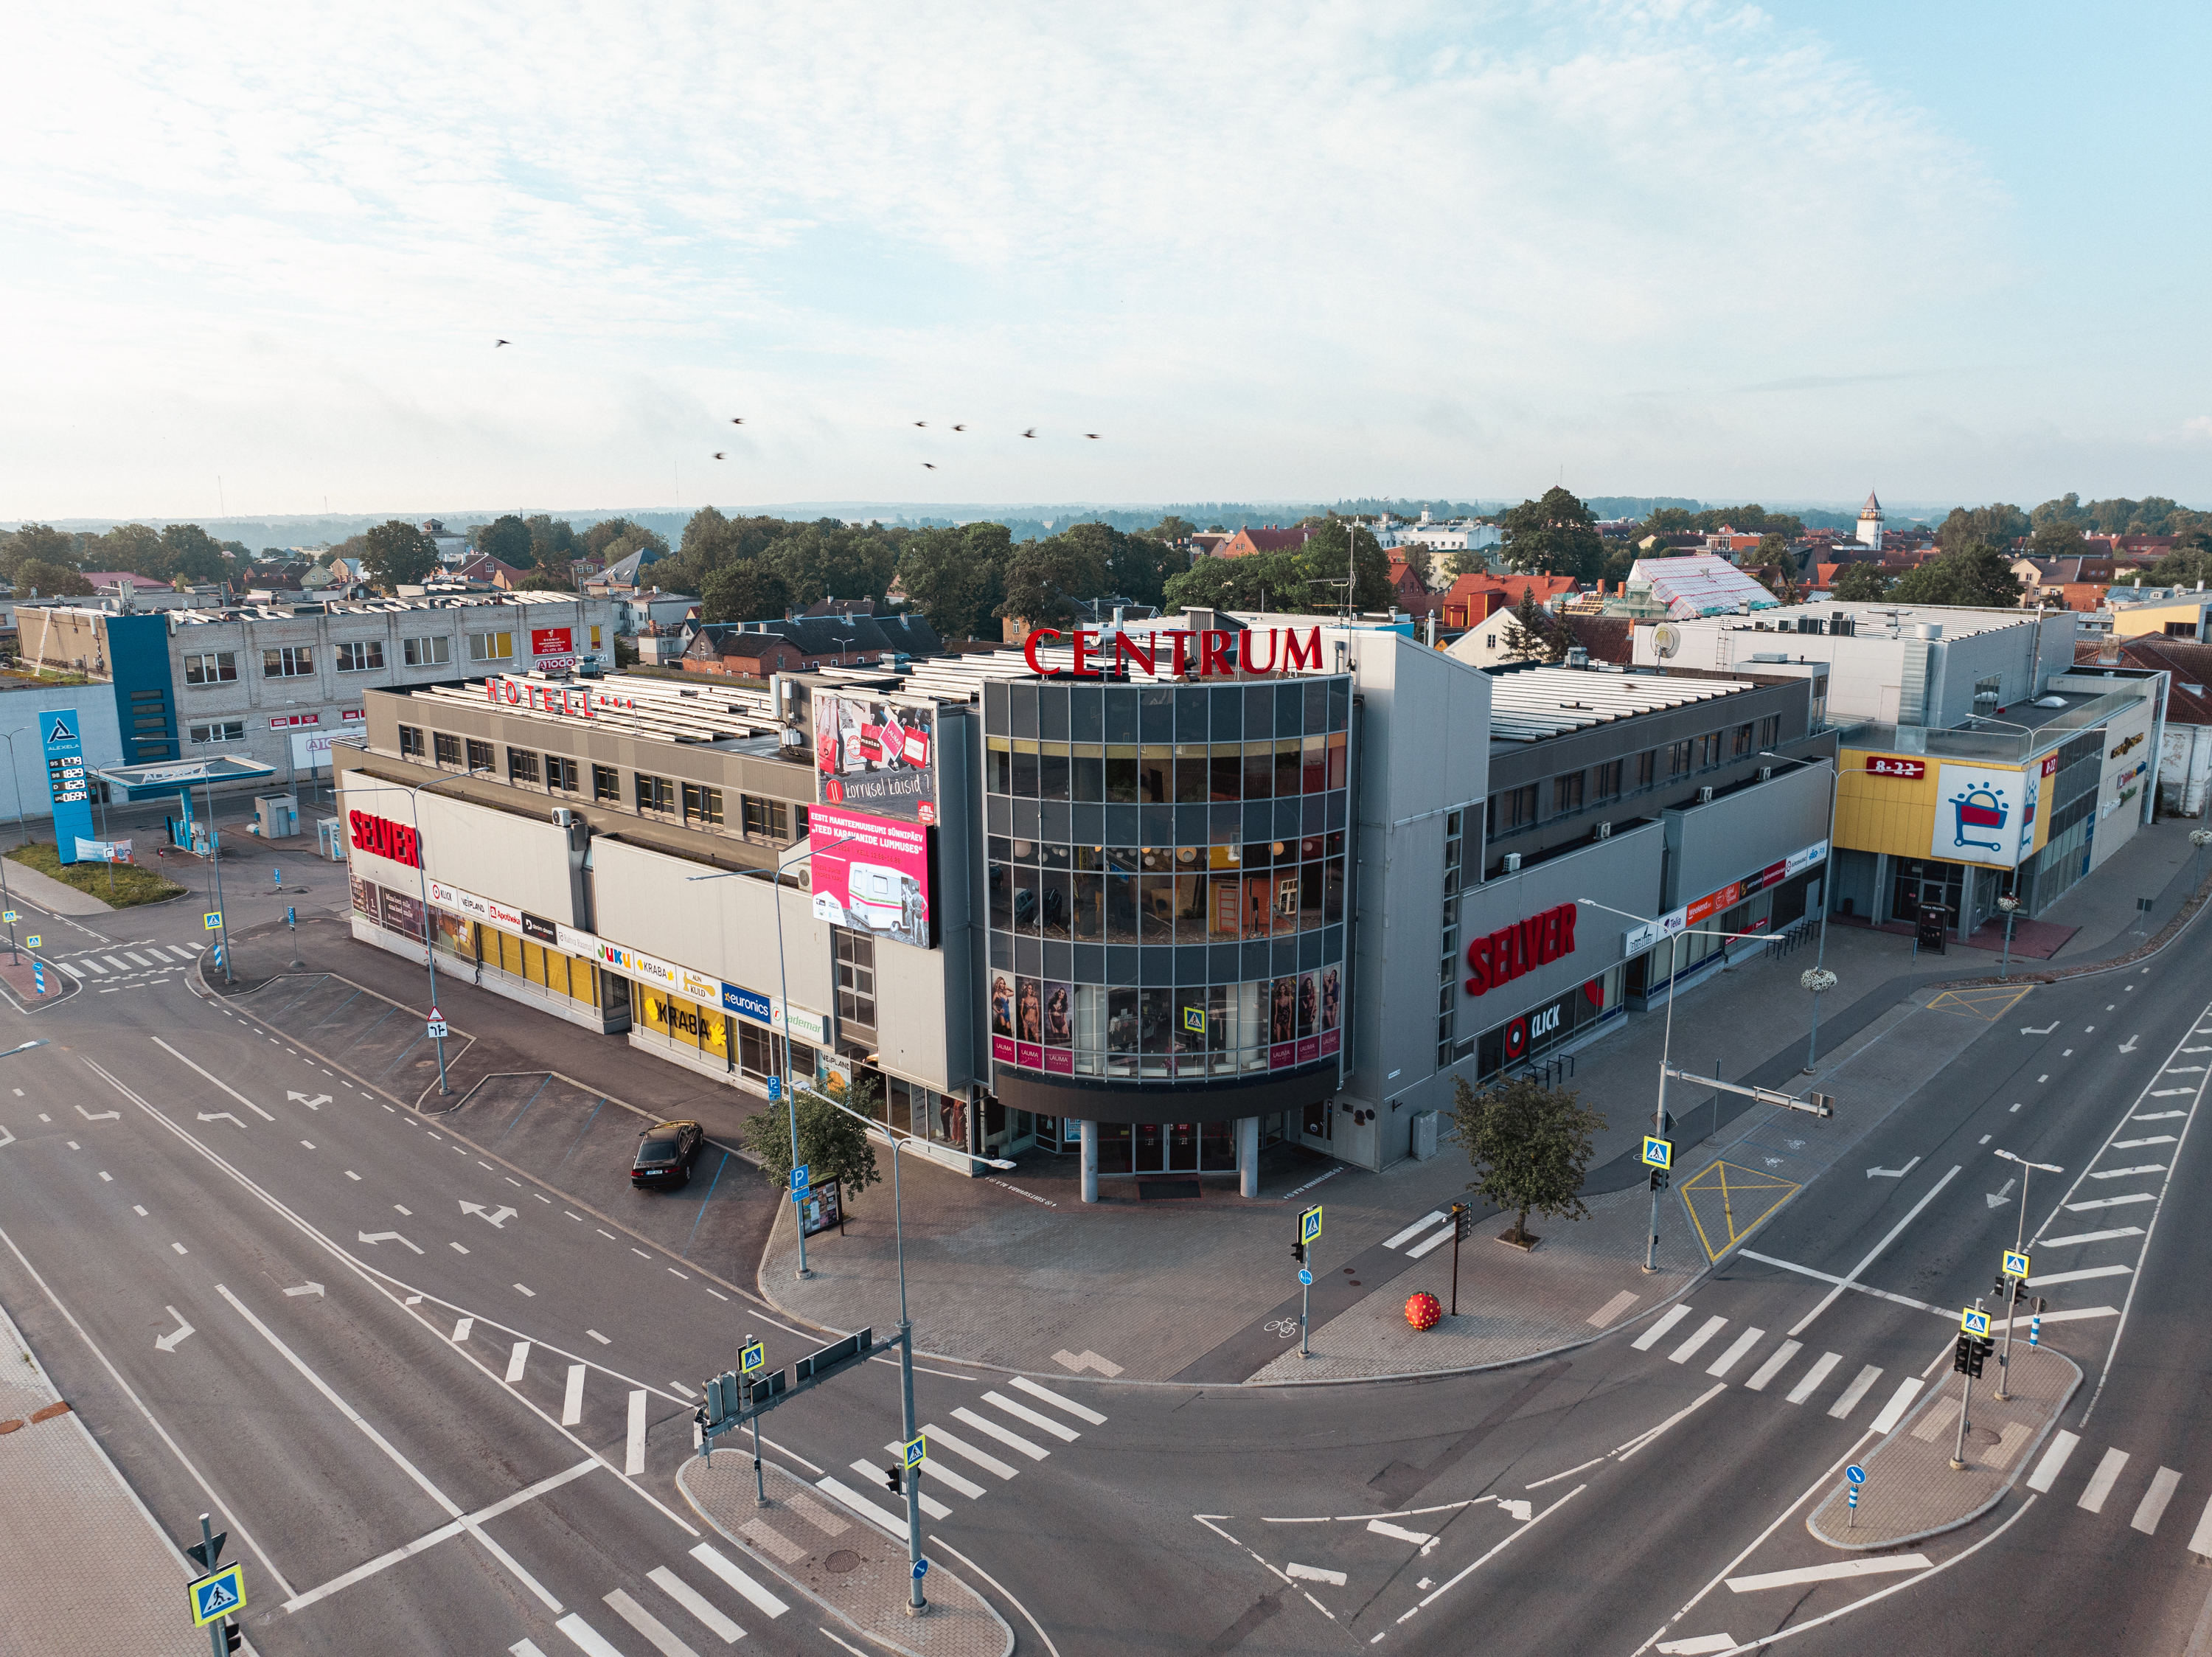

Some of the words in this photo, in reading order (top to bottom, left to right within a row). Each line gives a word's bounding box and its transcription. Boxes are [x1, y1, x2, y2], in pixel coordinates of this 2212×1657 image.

[1024, 625, 1324, 676] CENTRUM
[485, 677, 598, 718] HOTELL
[48, 743, 80, 751] ALEXELA
[2045, 758, 2056, 774] 8-22
[844, 777, 886, 799] korrusel
[887, 774, 922, 796] käisid
[810, 812, 828, 823] EESTI
[829, 816, 887, 835] MAANTEEMUUSEUMI
[888, 827, 923, 843] SÜNNIPÄEV
[349, 809, 420, 870] SELVER
[833, 828, 878, 846] KARAVANIDE
[856, 850, 870, 858] KELL
[439, 891, 453, 901] KLICK
[497, 910, 521, 925] Apotheka
[1670, 917, 1682, 929] Telia
[1466, 902, 1577, 997] SELVER
[643, 961, 668, 979] KRABA
[692, 974, 702, 983] AUN
[690, 985, 706, 998] KULD
[730, 993, 769, 1017] euronics
[658, 1001, 710, 1041] KRABA
[784, 1014, 822, 1033] ademar
[996, 1042, 1012, 1052] LAUMA
[1020, 1049, 1040, 1058] LAUMA
[1048, 1055, 1069, 1063] LAUMA
[795, 1170, 804, 1187] P
